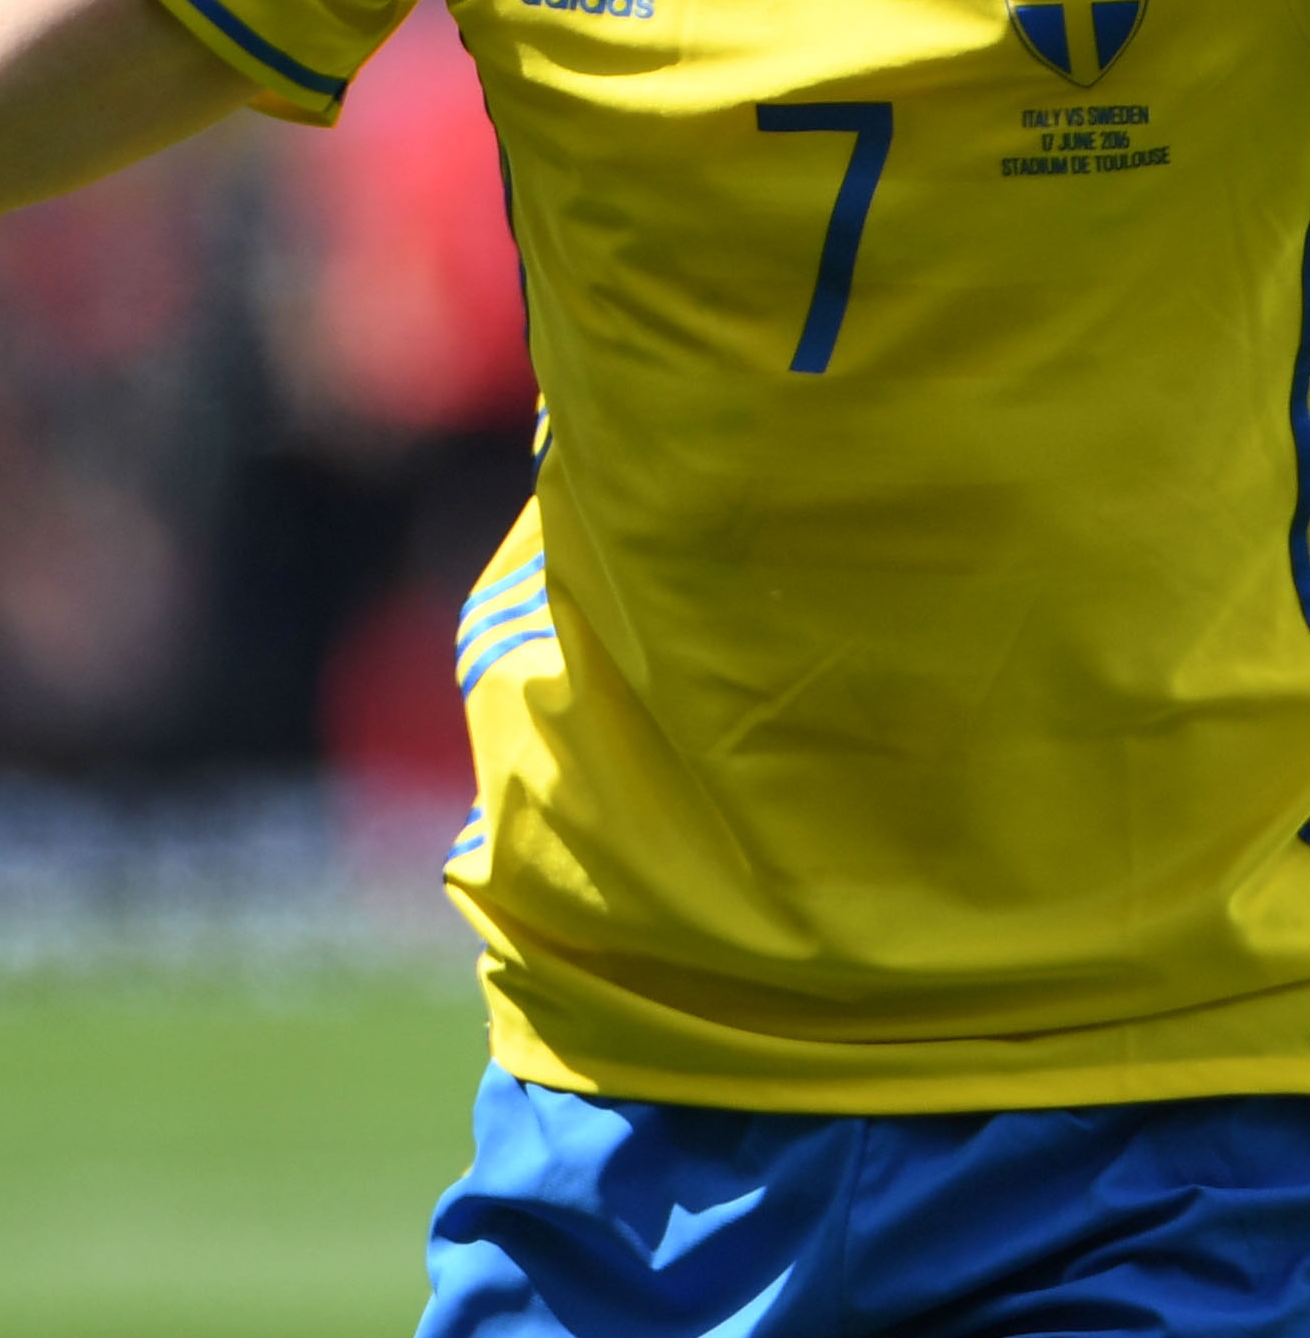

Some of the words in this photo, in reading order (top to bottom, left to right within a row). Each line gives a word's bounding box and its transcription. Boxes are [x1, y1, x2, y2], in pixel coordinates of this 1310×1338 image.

[1022, 109, 1061, 128] ITALY
[1066, 107, 1085, 127] VS
[1088, 105, 1150, 125] SWEDEN
[1042, 133, 1054, 151] 17
[1059, 132, 1096, 151] JUNE
[1100, 130, 1130, 150] 2016
[1001, 157, 1067, 176] STADIUM
[1072, 155, 1091, 174] DE
[1095, 146, 1171, 172] TOULOUSE
[756, 102, 893, 374] 7
